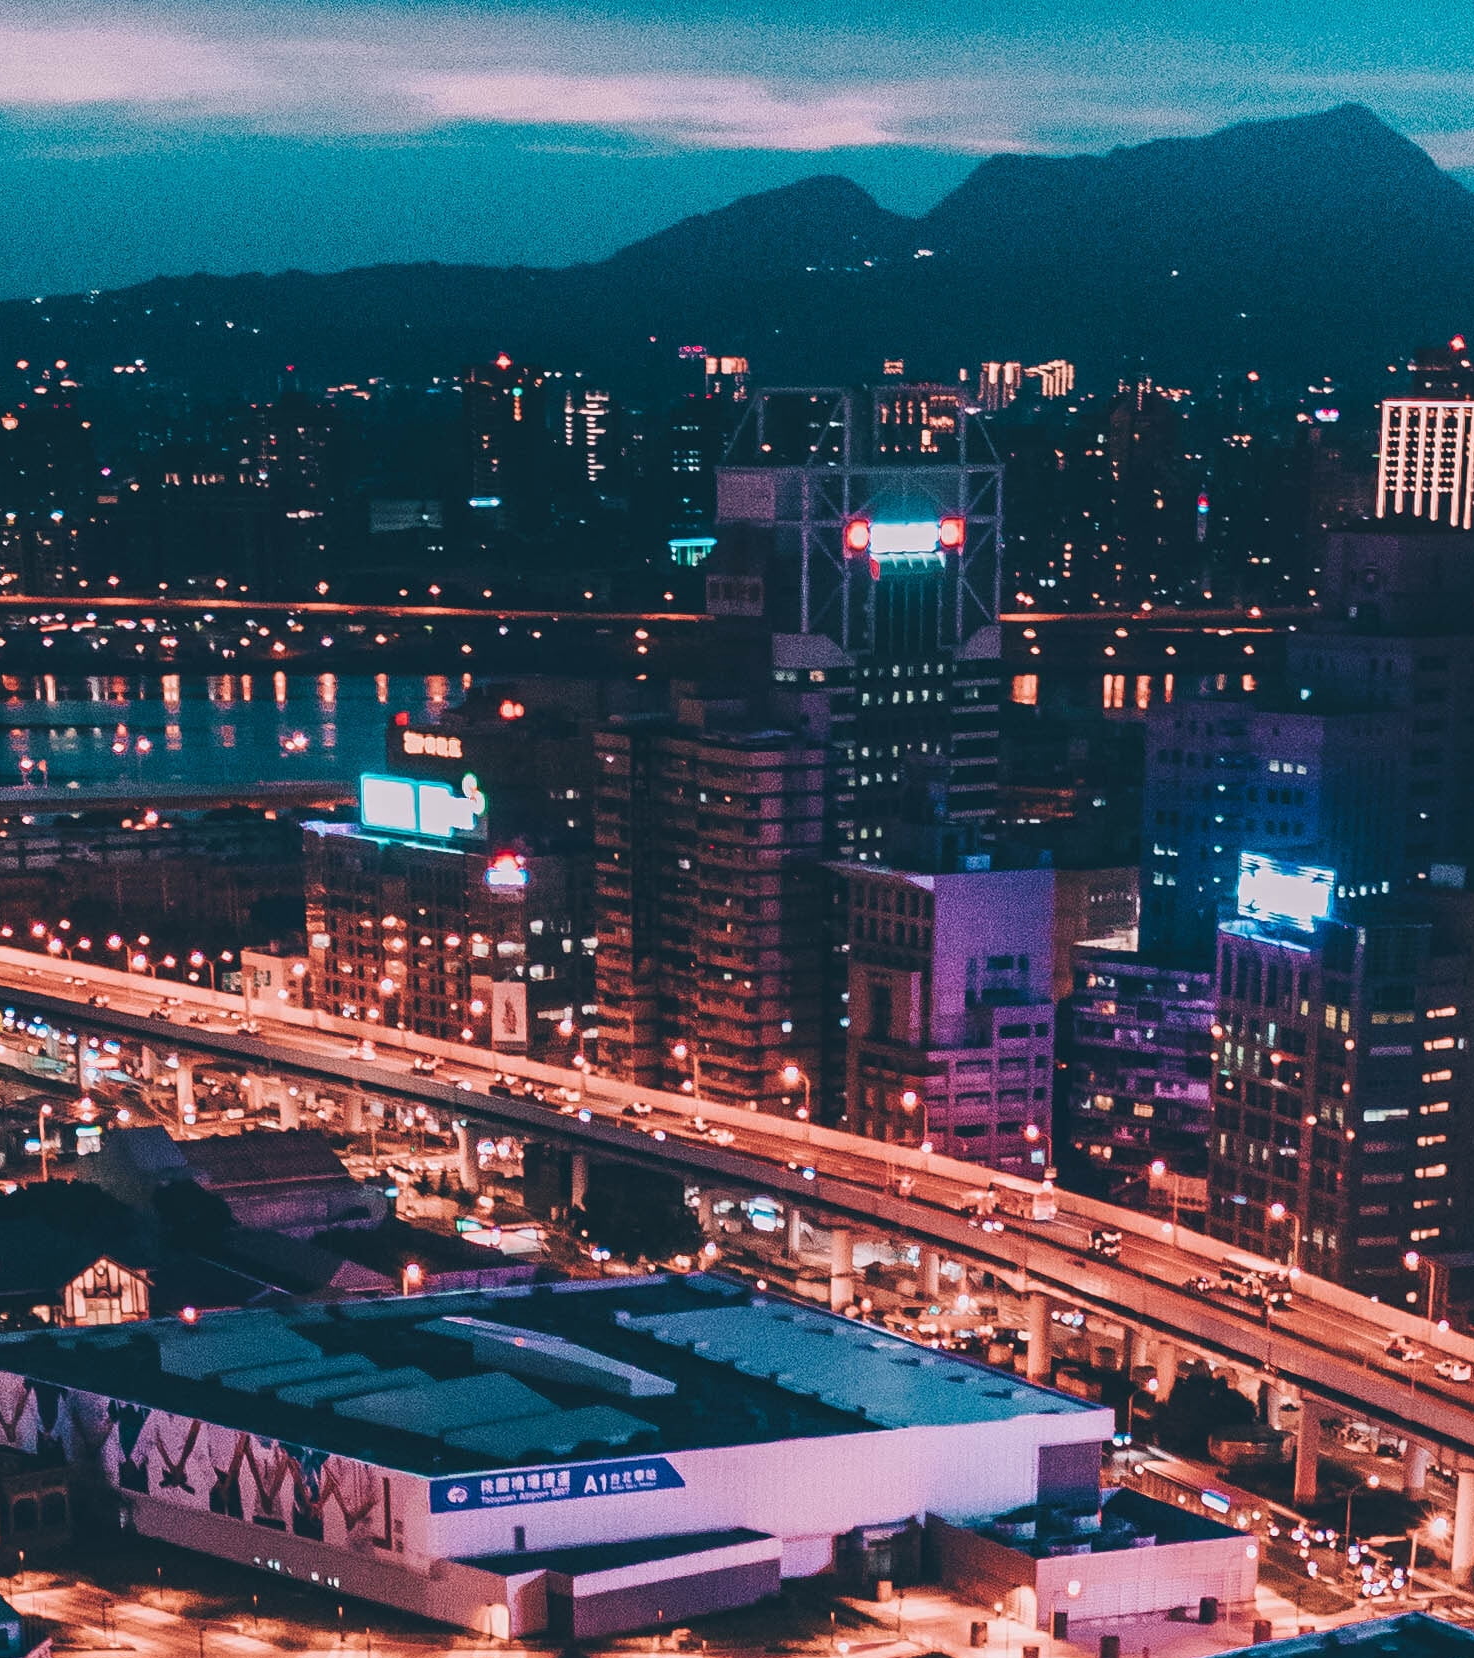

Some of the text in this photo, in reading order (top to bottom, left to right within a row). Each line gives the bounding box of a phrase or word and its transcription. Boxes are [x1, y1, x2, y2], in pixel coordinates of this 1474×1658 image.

[479, 1469, 572, 1496] 桃園機場捷運
[584, 1473, 608, 1495] A1
